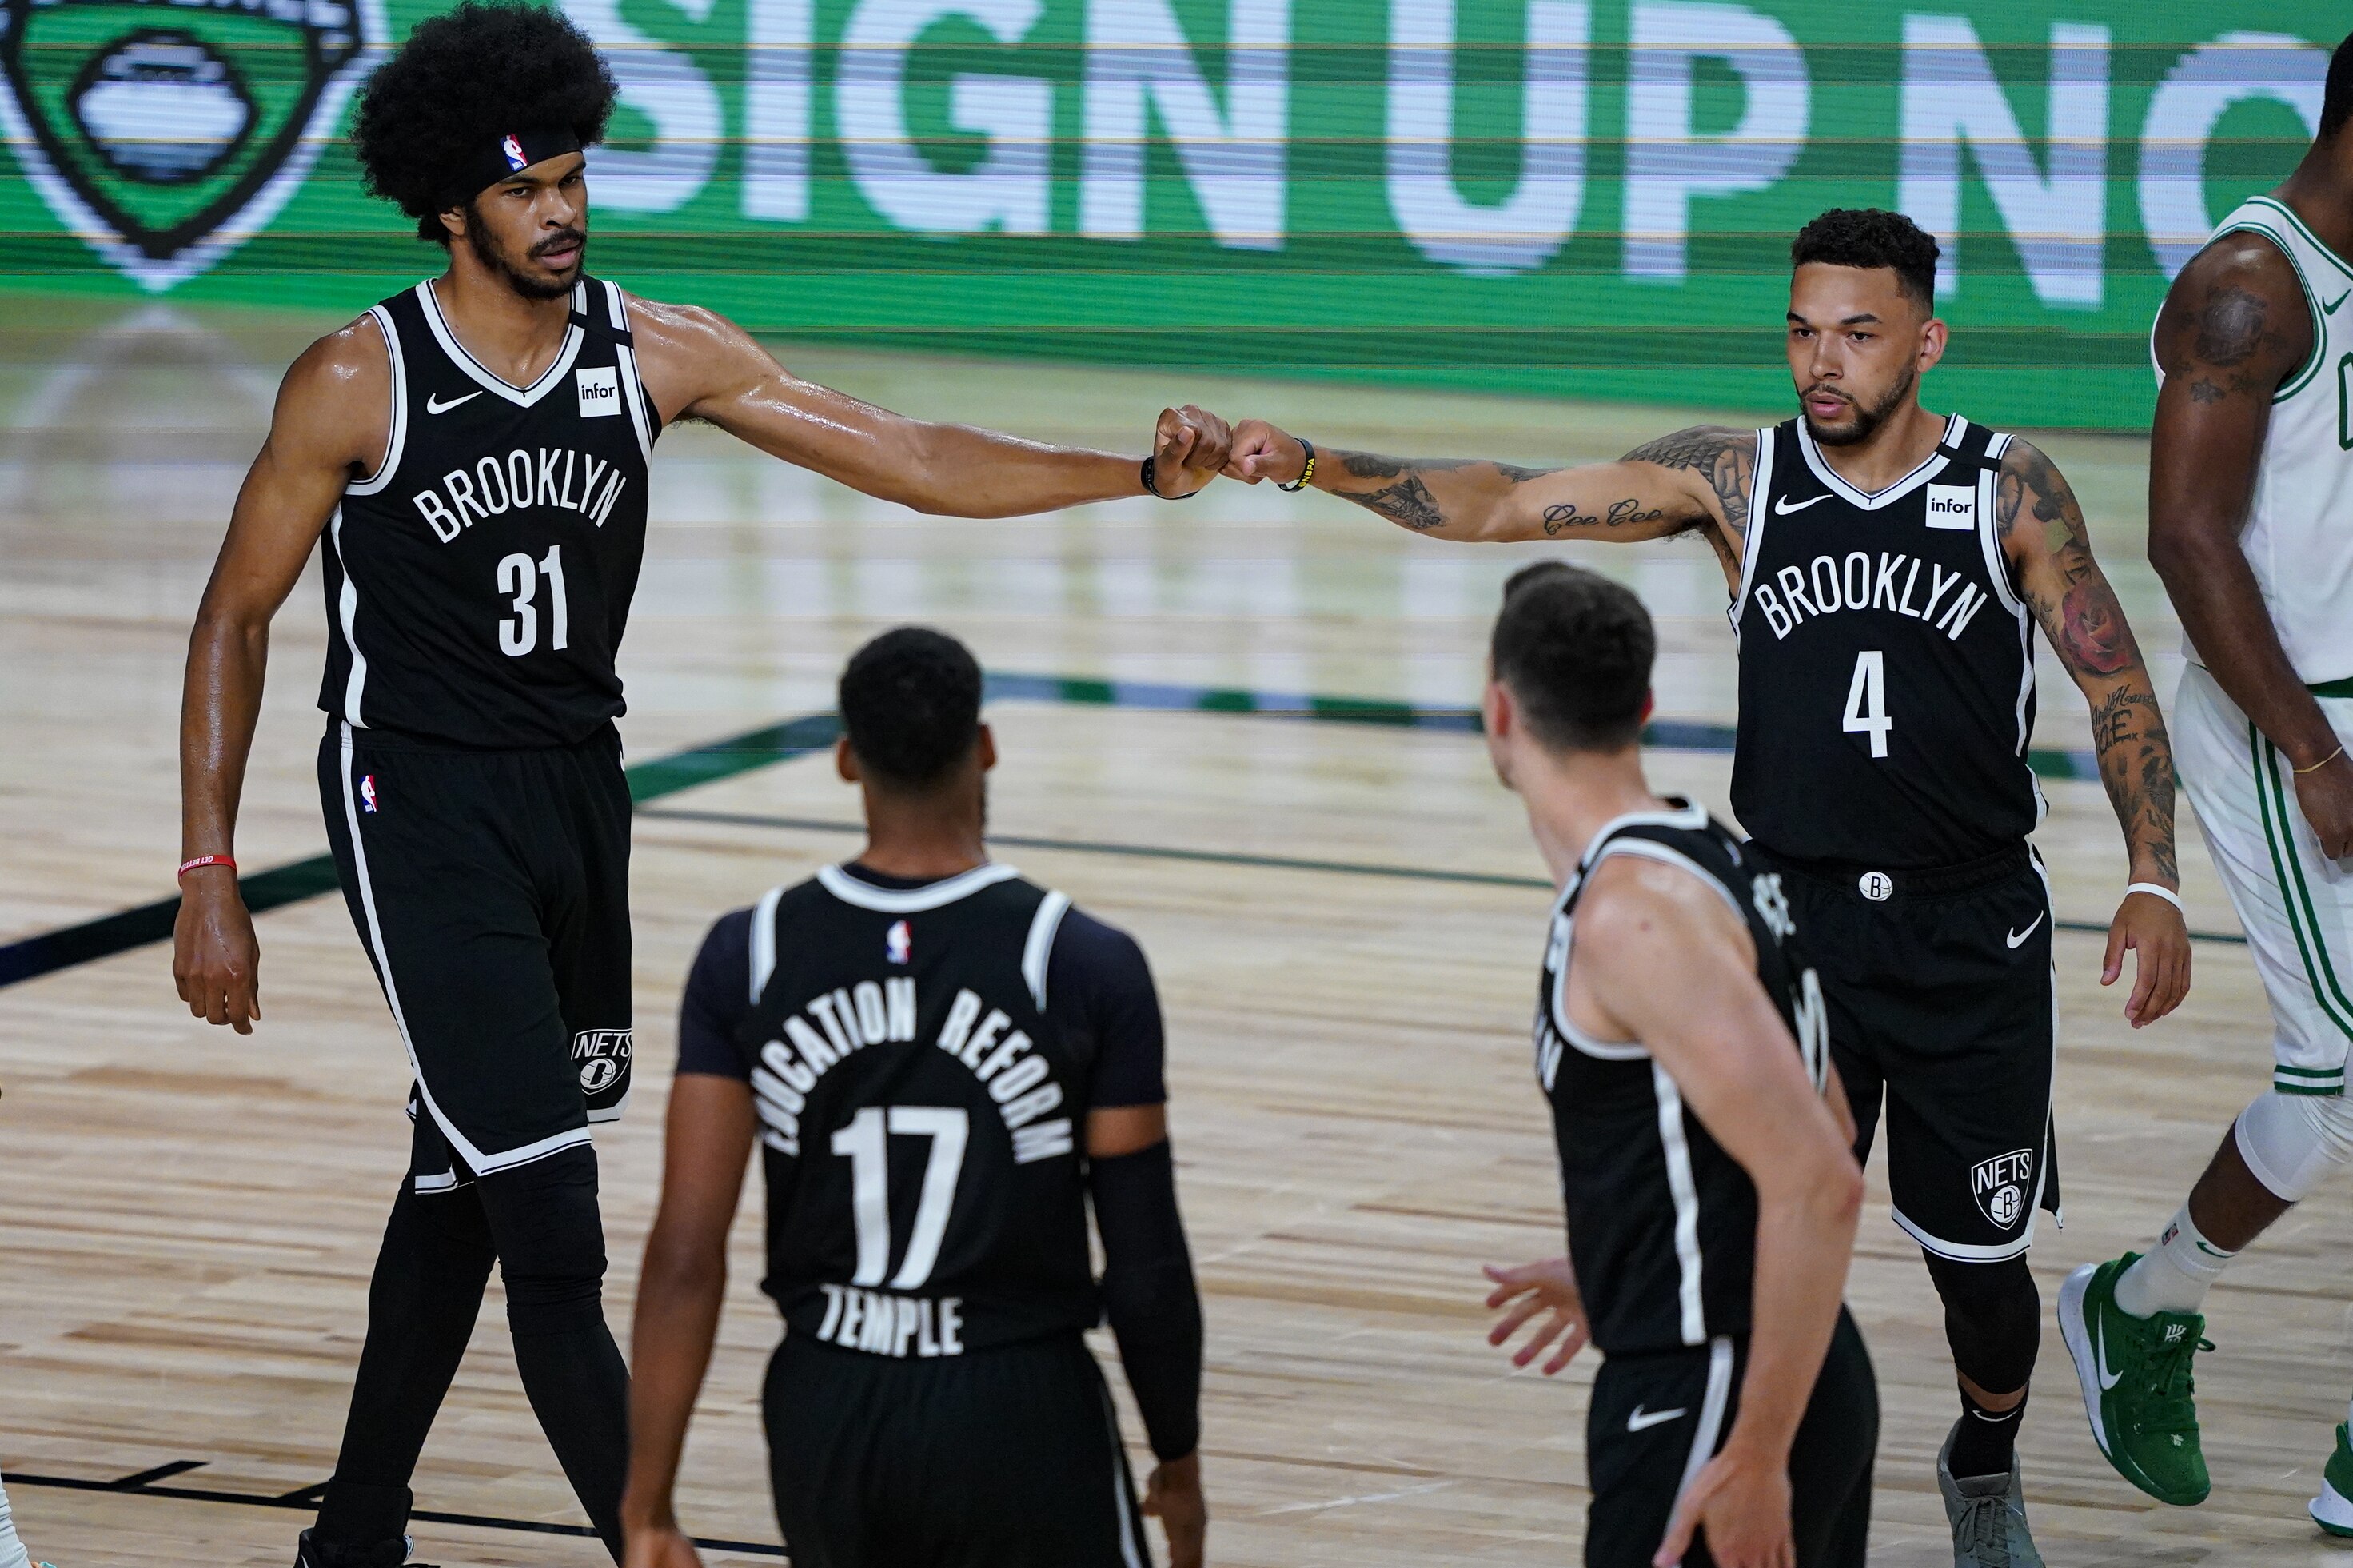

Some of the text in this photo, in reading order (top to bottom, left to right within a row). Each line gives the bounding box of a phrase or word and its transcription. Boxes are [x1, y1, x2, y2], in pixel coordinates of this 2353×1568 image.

[556, 0, 1287, 252] SIGN
[1385, 0, 1811, 285] UP
[581, 382, 616, 400] infor
[413, 447, 627, 544] BROOKLYN
[1930, 497, 1972, 514] infor
[497, 544, 568, 657] 31
[1754, 551, 1988, 641] BROOKLYN
[1842, 650, 1892, 758] 4
[574, 1031, 632, 1059] NETS
[936, 988, 1075, 1165] REFORM
[830, 1105, 970, 1291] 17
[1977, 1151, 2031, 1195] NETS
[816, 1283, 964, 1358] TEMPLE
